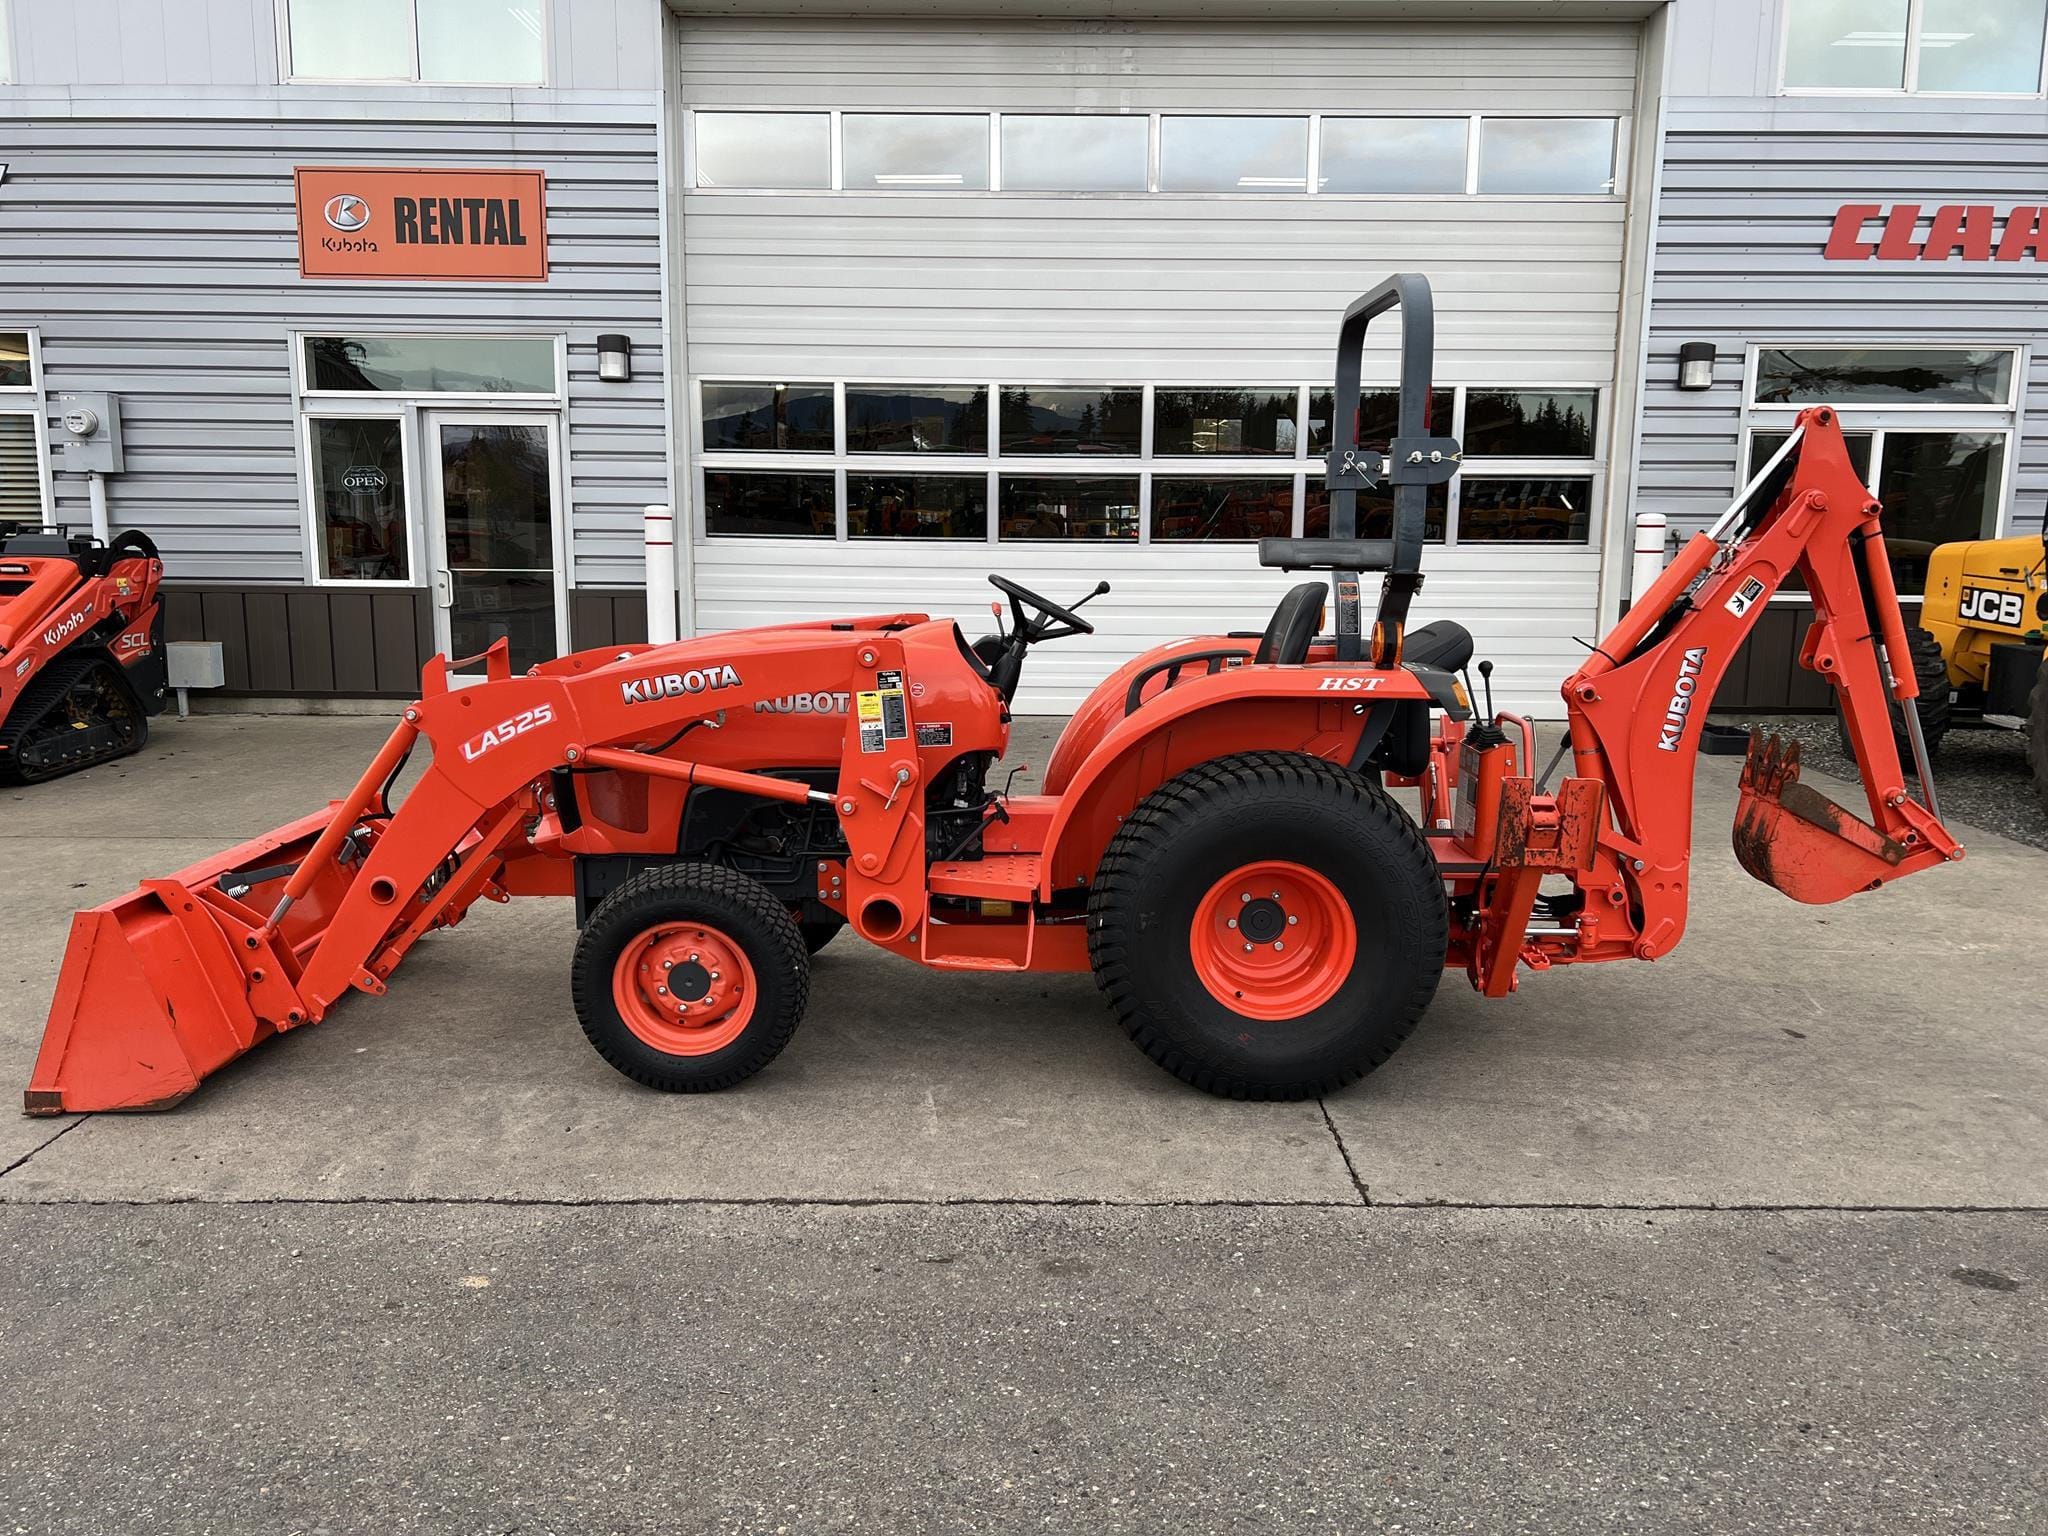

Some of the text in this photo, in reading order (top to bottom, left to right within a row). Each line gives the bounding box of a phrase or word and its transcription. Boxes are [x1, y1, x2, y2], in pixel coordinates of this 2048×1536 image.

[393, 197, 527, 246] RENTAL
[321, 238, 379, 252] Kubota
[344, 476, 385, 487] OPEN
[1961, 590, 2022, 625] JCB
[44, 612, 84, 646] Kubota
[121, 633, 150, 649] SCL
[620, 664, 744, 705] KUBOTA
[1316, 676, 1386, 692] HST
[1656, 646, 1708, 753] KUBOTA
[753, 692, 851, 714] KUBOT
[463, 703, 553, 761] LA525
